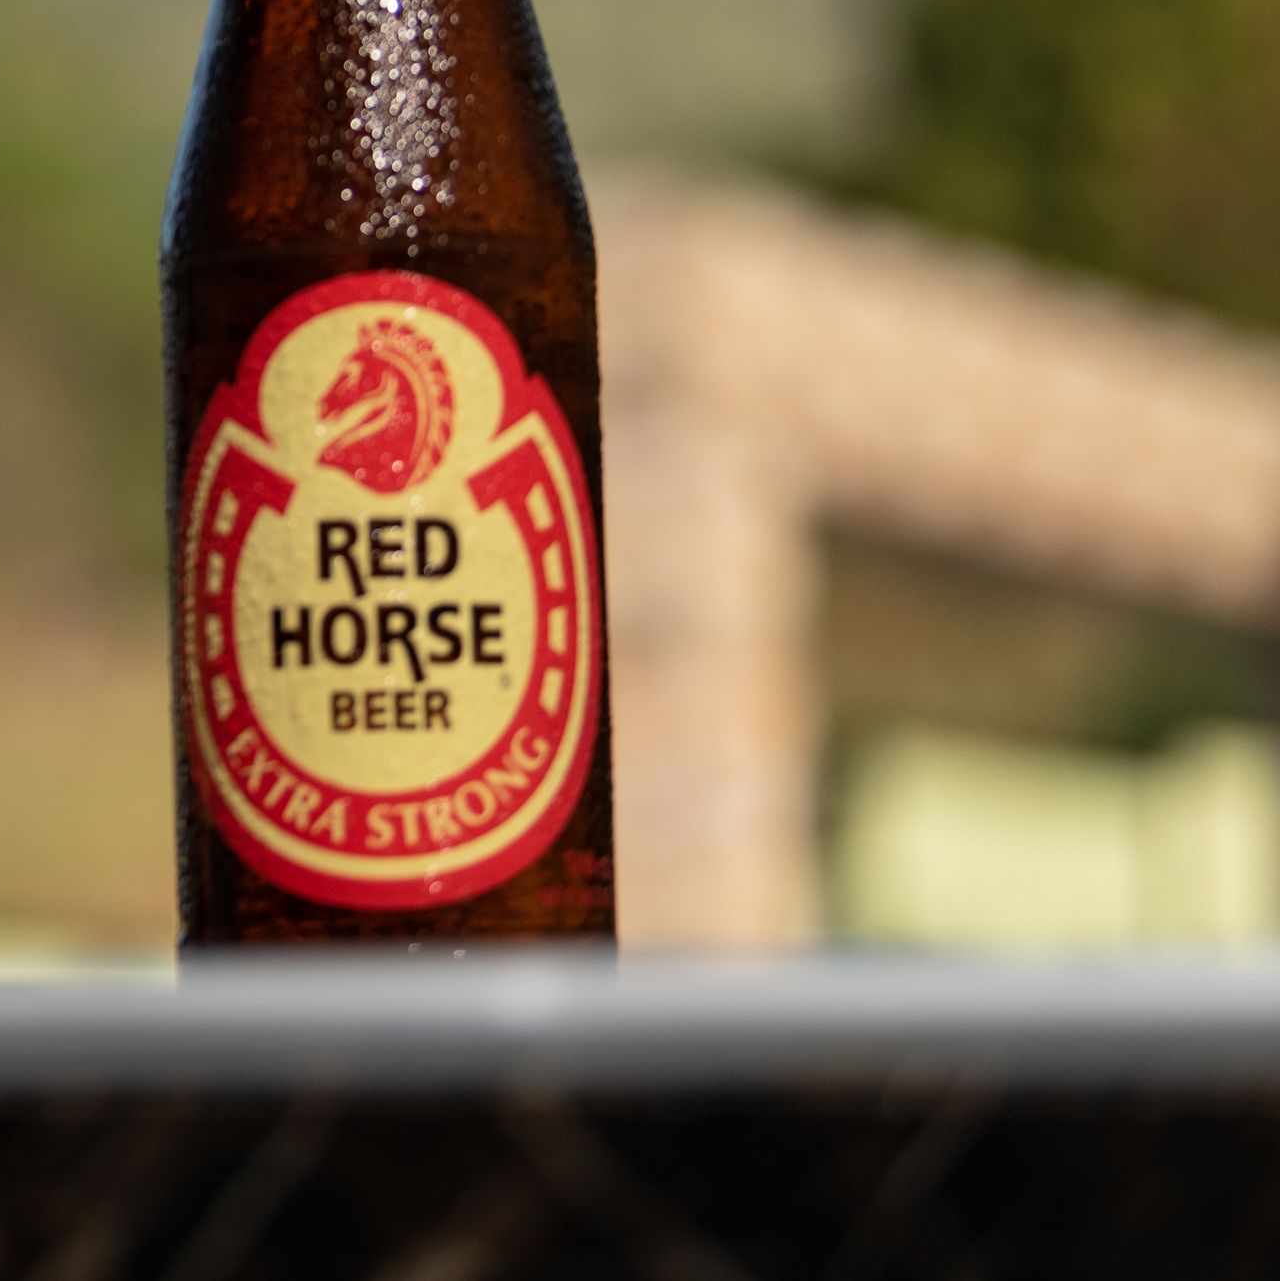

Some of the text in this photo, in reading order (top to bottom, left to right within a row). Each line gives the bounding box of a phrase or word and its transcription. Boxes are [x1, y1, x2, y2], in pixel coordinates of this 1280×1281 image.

[318, 518, 460, 597] RED
[271, 604, 506, 682] HORSE
[330, 689, 452, 733] BEER
[225, 726, 550, 850] EXTRA STRONG
